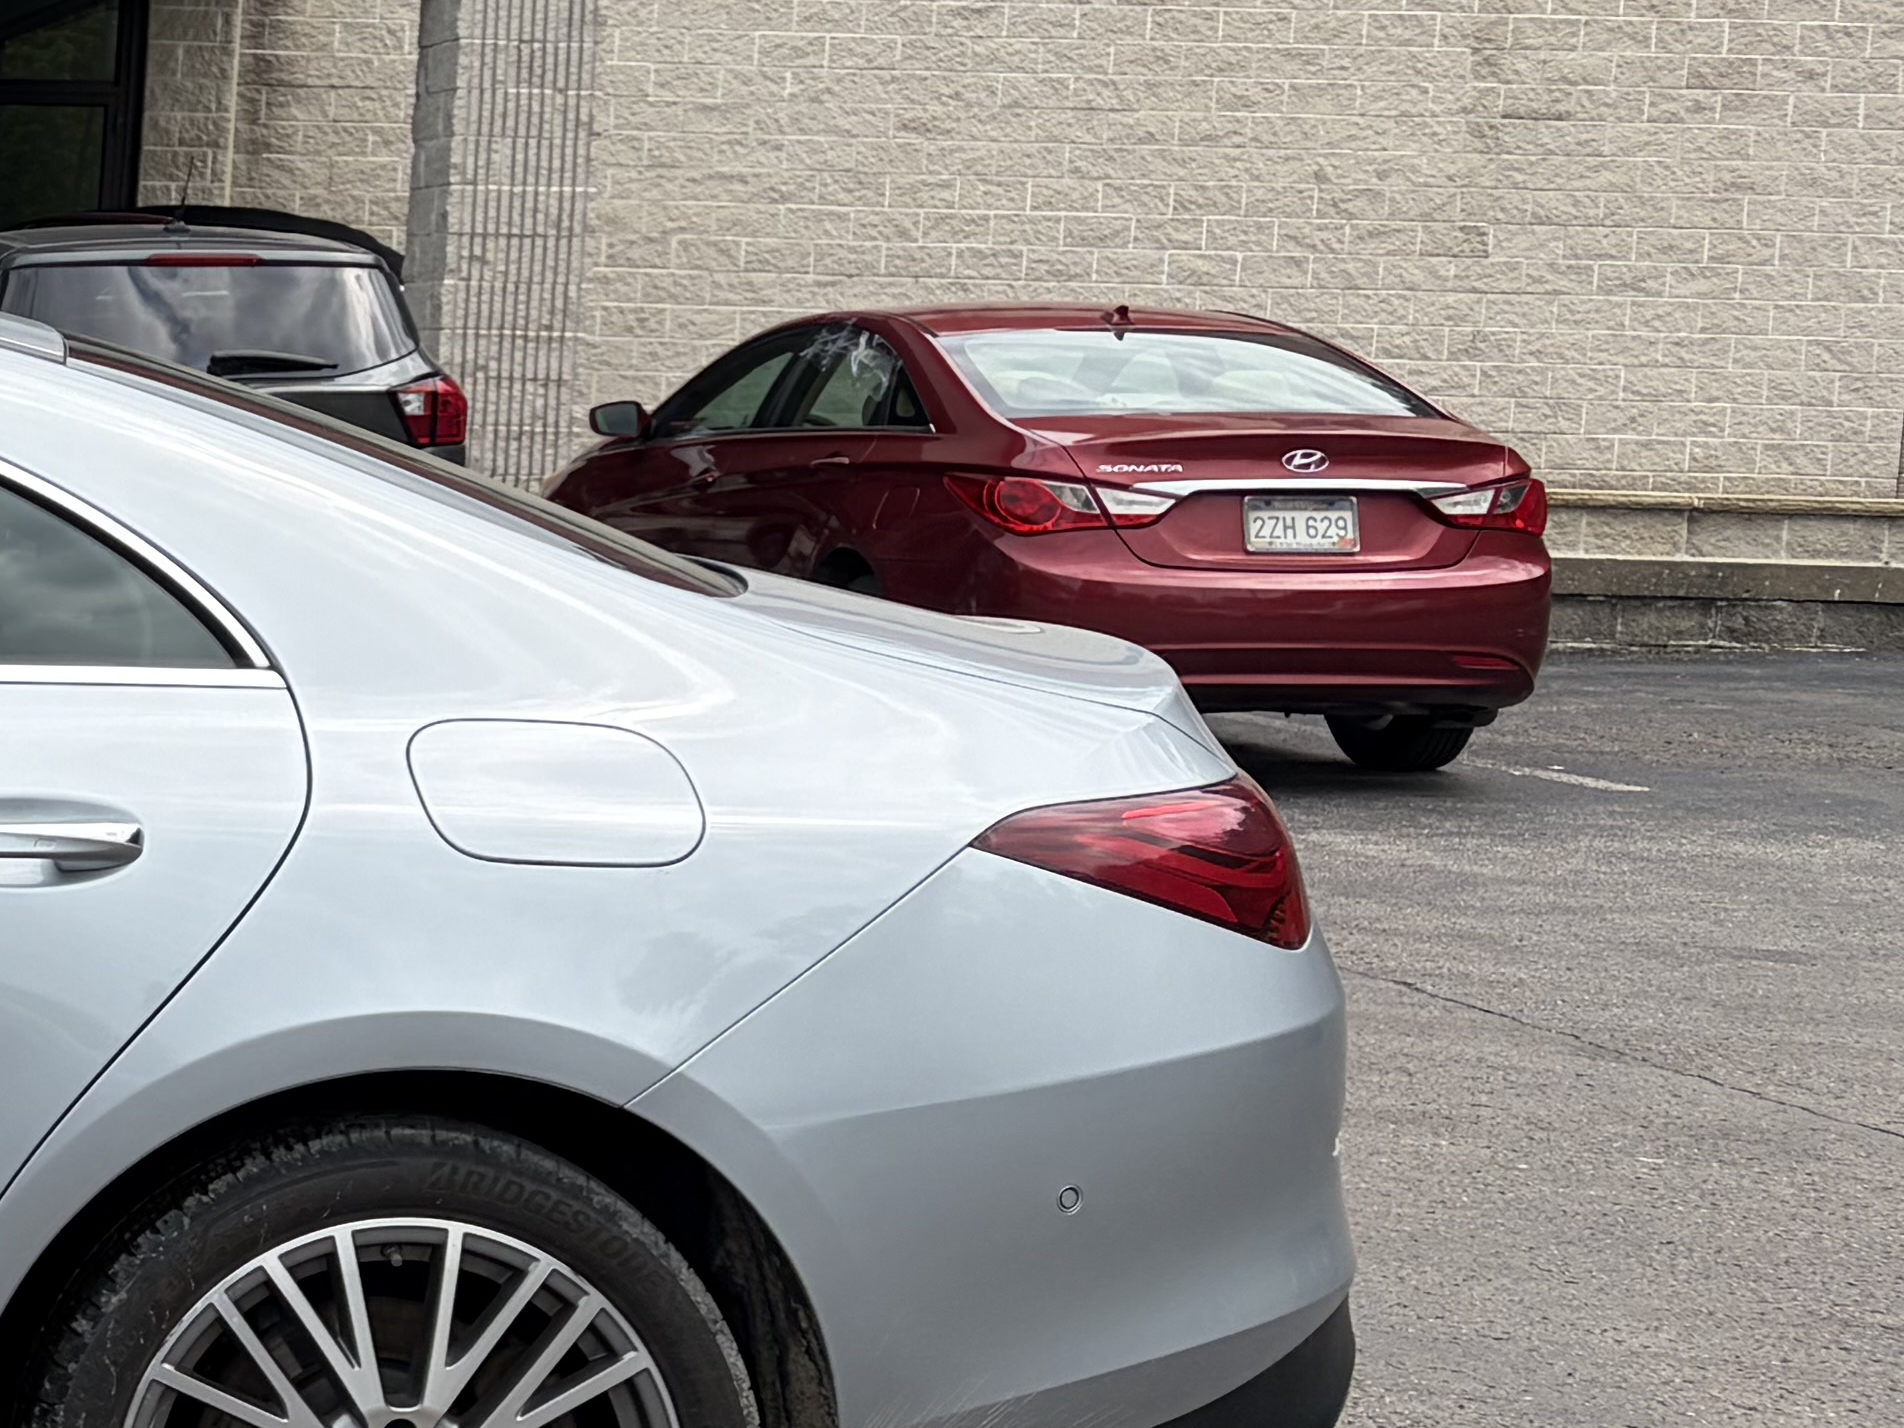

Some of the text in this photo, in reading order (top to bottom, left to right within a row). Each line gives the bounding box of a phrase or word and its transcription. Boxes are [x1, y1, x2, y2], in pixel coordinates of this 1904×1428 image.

[1096, 464, 1183, 473] SONATA
[1253, 516, 1348, 540] 2ZH 629
